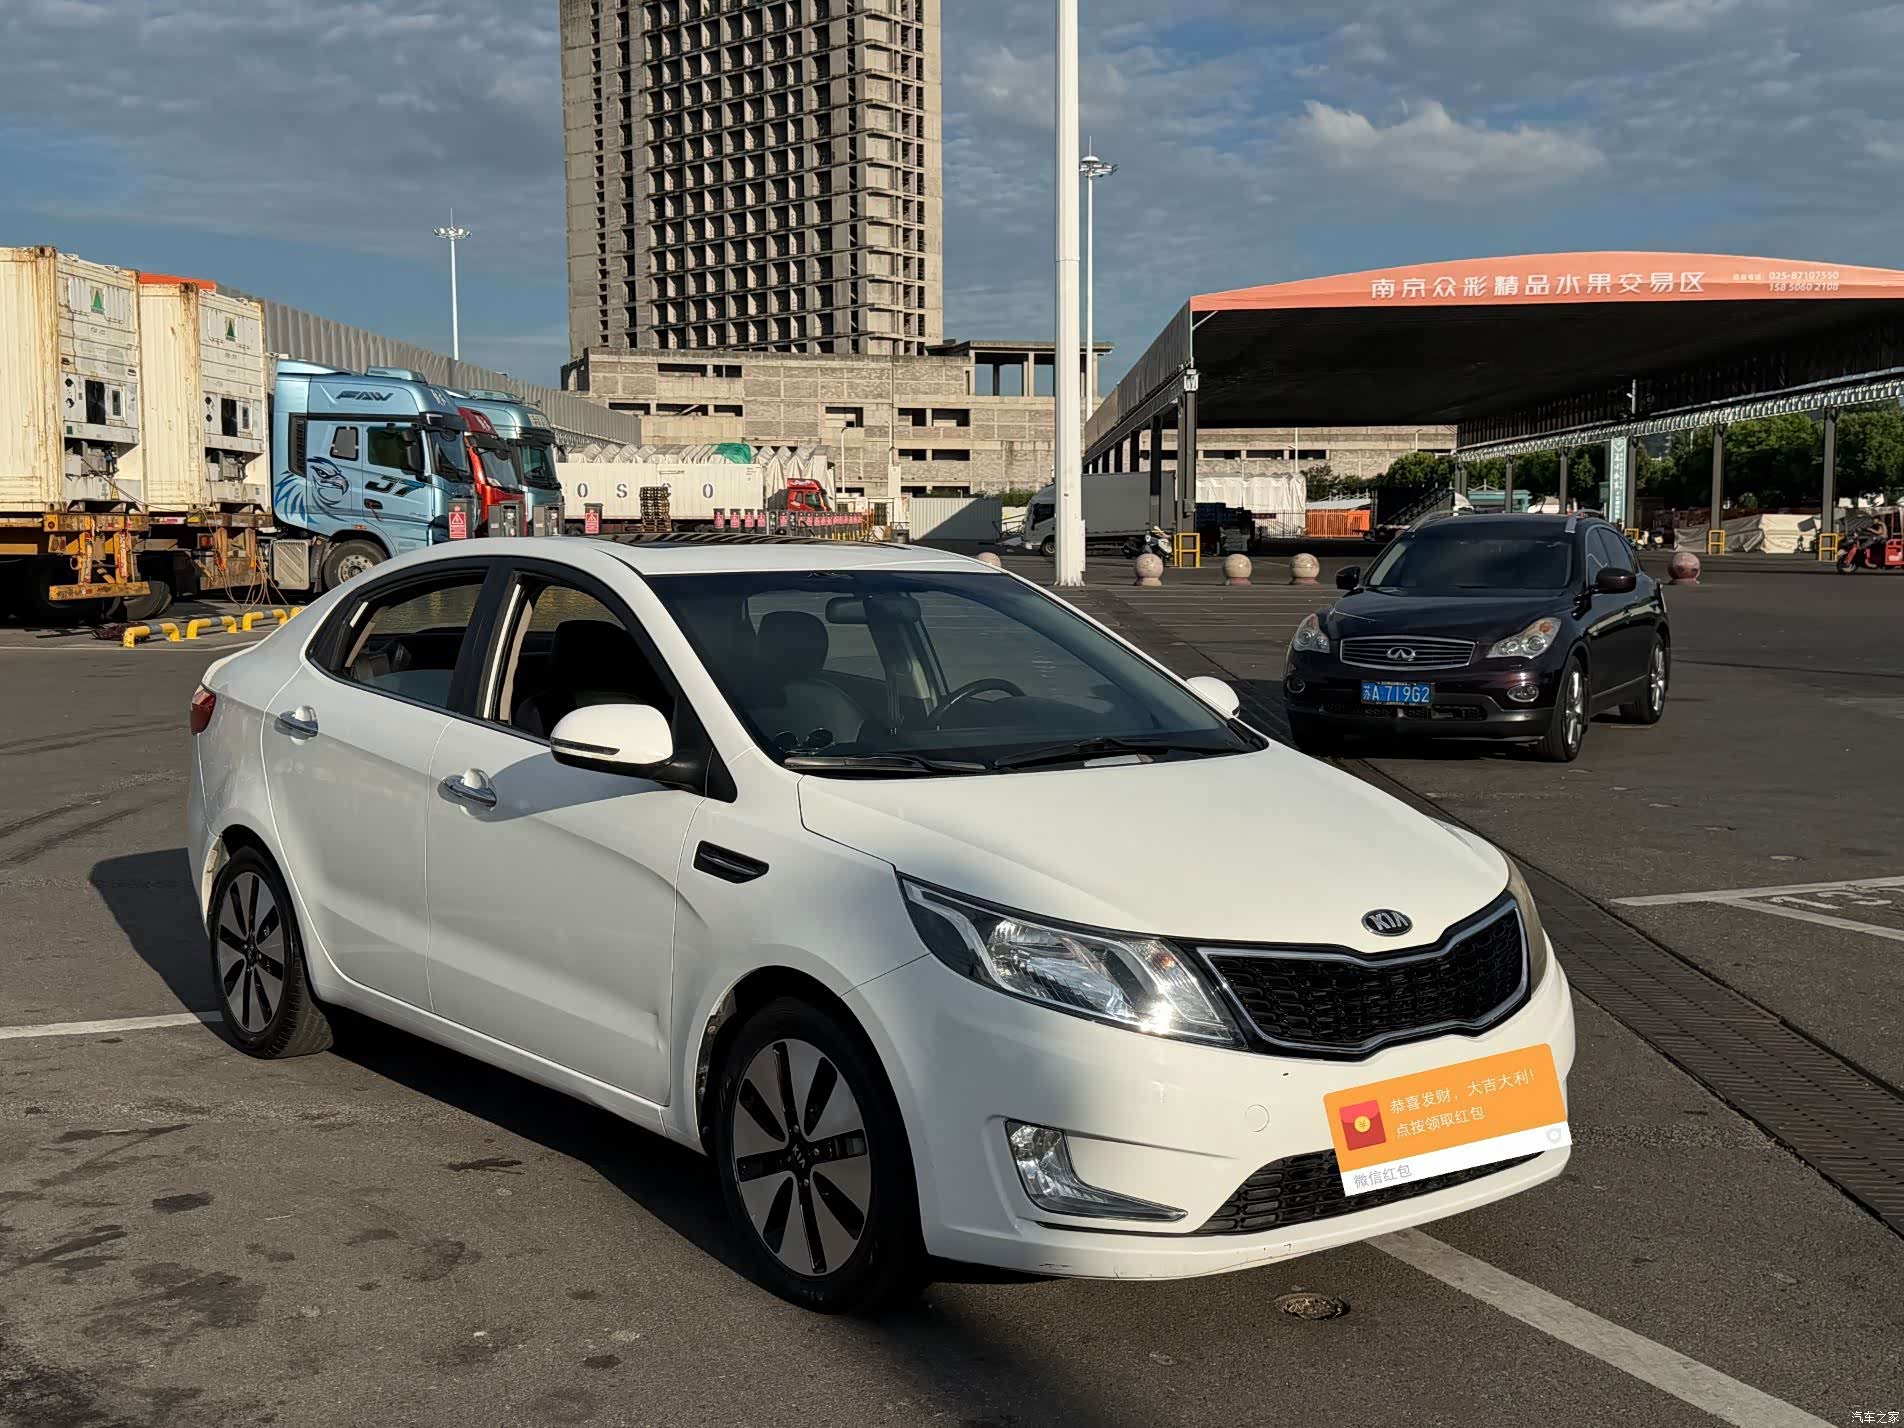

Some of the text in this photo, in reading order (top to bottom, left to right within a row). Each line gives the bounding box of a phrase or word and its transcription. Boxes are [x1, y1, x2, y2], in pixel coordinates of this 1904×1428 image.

[1370, 272, 1706, 299] 南京众彩精品水果交易区
[336, 390, 394, 401] FAW
[365, 475, 426, 498] J7
[1368, 911, 1409, 931] KIA
[792, 1143, 806, 1169] KIA
